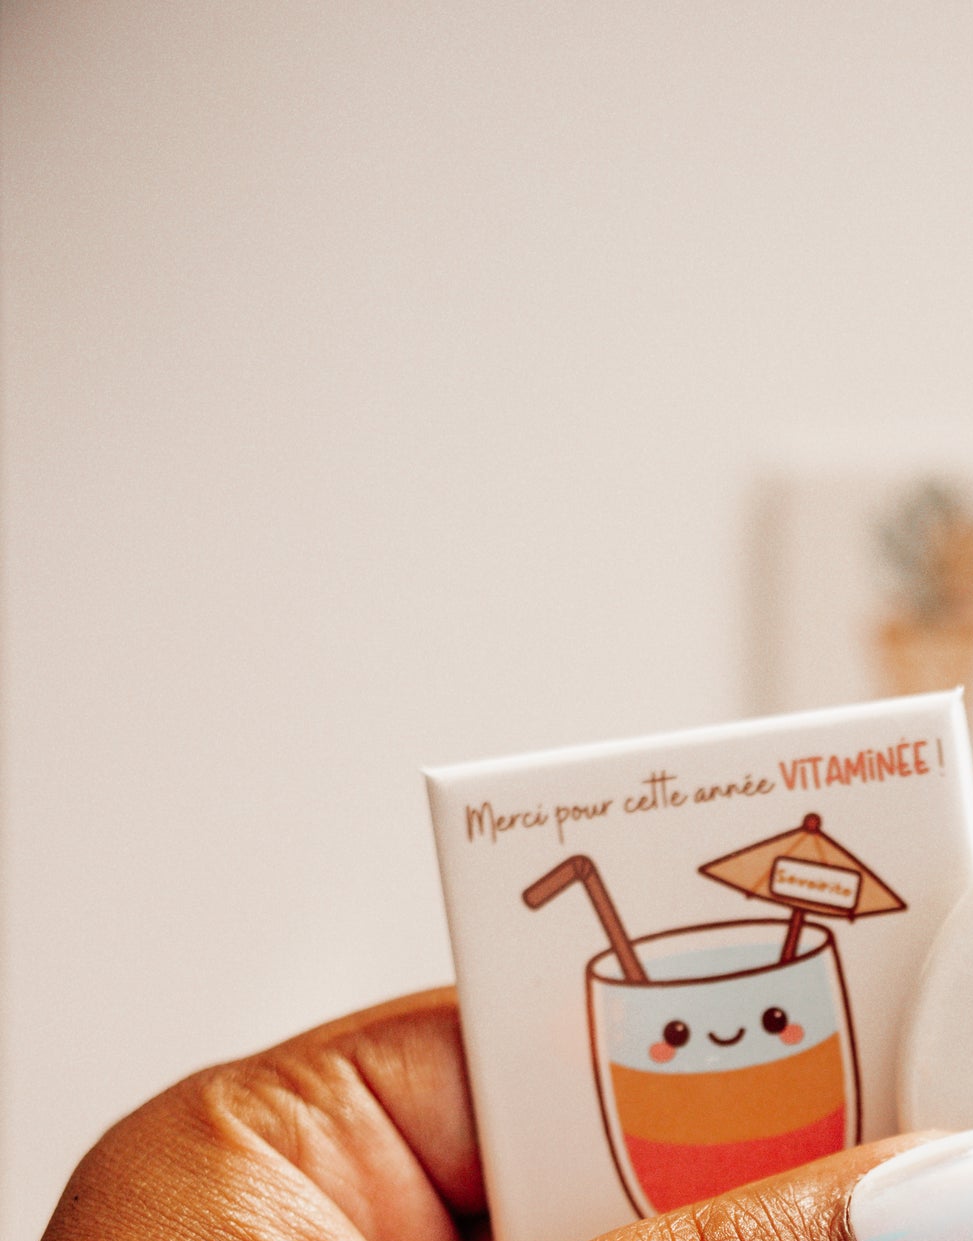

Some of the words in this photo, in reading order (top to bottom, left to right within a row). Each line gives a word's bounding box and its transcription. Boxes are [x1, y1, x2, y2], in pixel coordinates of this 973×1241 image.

[465, 799, 547, 844] Merci
[554, 795, 615, 845] pour
[622, 768, 689, 815] cette
[692, 776, 776, 805] année
